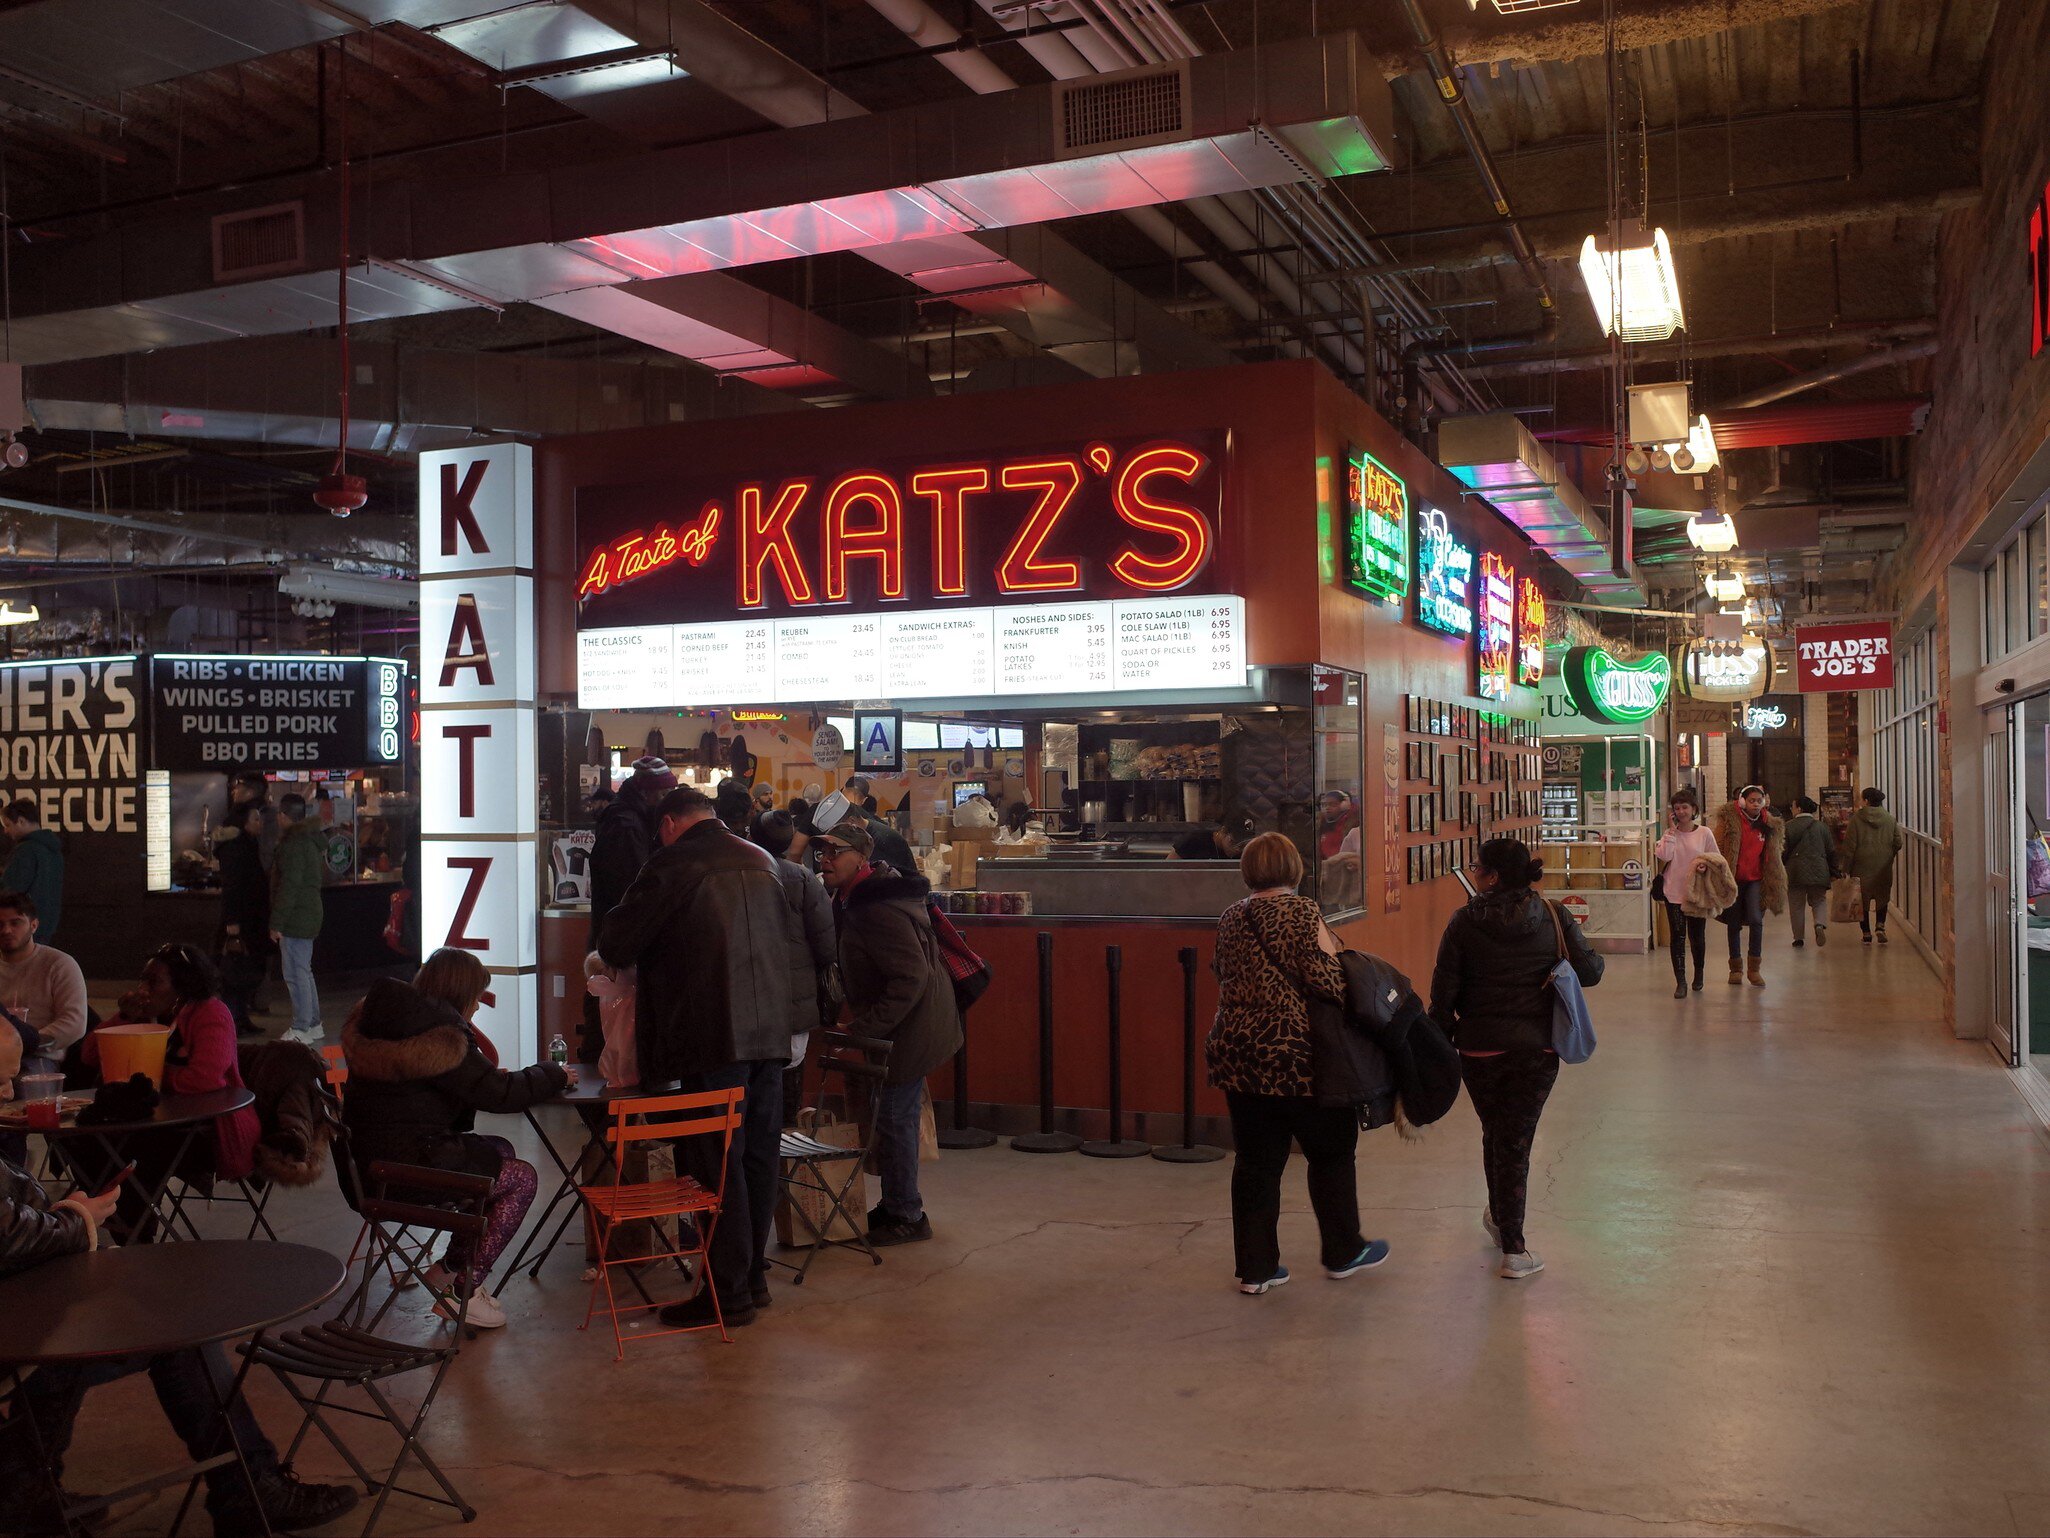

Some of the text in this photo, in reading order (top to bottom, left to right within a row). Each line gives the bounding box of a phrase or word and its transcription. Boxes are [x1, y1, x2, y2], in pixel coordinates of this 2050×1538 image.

[576, 443, 1209, 609] A Taste of KATZ'S
[1013, 613, 1094, 624] NOSHES AND SIDES:
[1120, 607, 1230, 621] POTATO SALAD (1LB) 6.95
[781, 624, 874, 636] REUBEN 23.45
[898, 621, 976, 631] SANDWICH EXTRAS:
[1003, 624, 1105, 637] FRANKFURTER 3.95
[1121, 619, 1231, 632] COLE SLAW (1LB) 6.95
[583, 635, 643, 647] THE CLASSICS
[681, 629, 766, 640] PASTRAMI 22.45
[1121, 630, 1231, 643] MAC SALAD (1LB) 6.95
[681, 641, 766, 653] CORNED BEEF 21.45
[1004, 638, 1105, 650] KNISH 5.45
[1120, 644, 1231, 657] QUART OF PICKLES 6.95
[1799, 637, 1889, 660] TRADER
[781, 652, 809, 661] COMBO
[1004, 655, 1035, 663] POTATO
[174, 661, 345, 682] RIBS CHICKEN
[1004, 663, 1032, 671] LATKES
[1122, 660, 1231, 671] SODA OR 2.95
[1811, 656, 1877, 677] JOE'S
[1004, 675, 1026, 683] FRIES
[1089, 672, 1106, 681] 7.45
[1122, 670, 1151, 678] WATER
[1705, 674, 1750, 687] PICKLES
[781, 677, 830, 686] CHEESESTEAK
[163, 688, 355, 708] WINGS BRISKET
[380, 664, 398, 760] BBQ
[182, 715, 338, 734] PULLED PORK
[865, 721, 891, 752] A
[202, 741, 319, 763] BBQ FRIES
